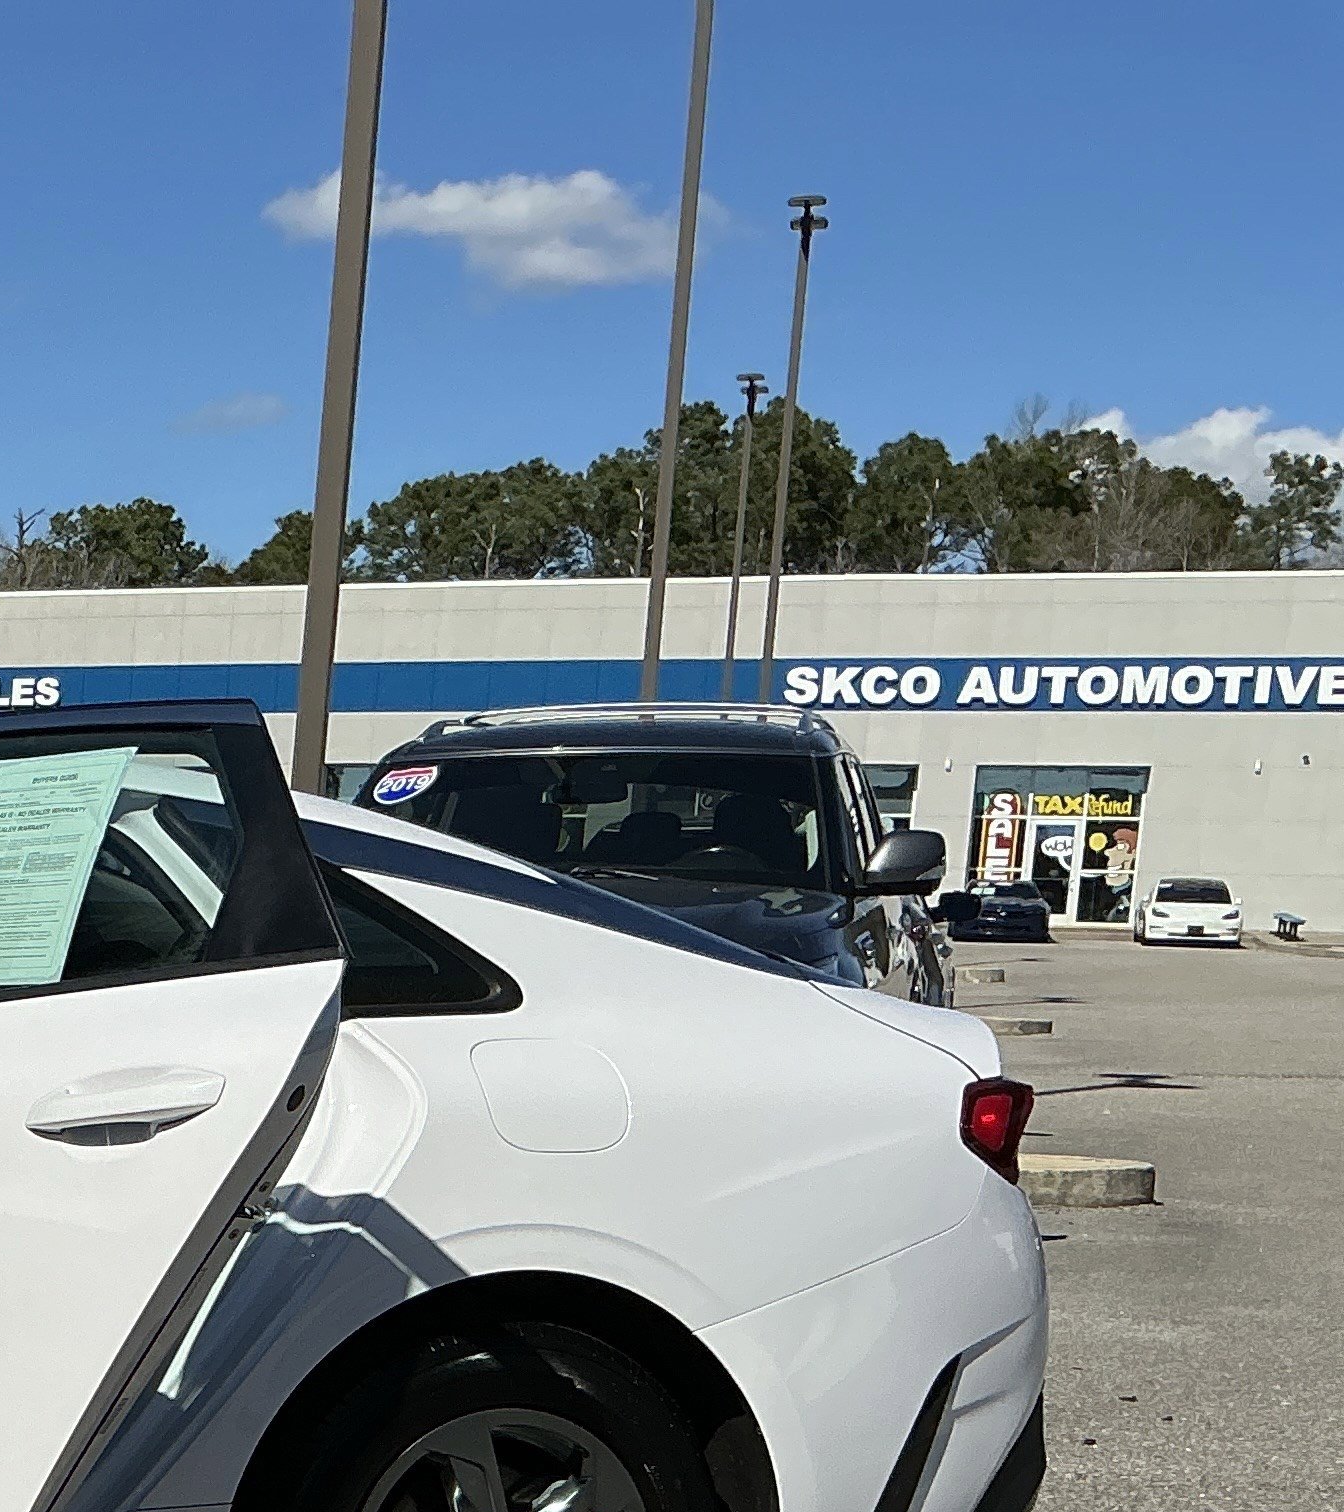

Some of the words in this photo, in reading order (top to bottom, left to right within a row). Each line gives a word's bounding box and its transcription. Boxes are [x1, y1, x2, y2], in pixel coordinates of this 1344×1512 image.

[783, 666, 942, 705] SKCO
[957, 665, 1344, 706] AUTOMOTIVE
[376, 775, 431, 794] 2019
[1034, 794, 1084, 815] TAX
[983, 793, 1015, 881] SALE
